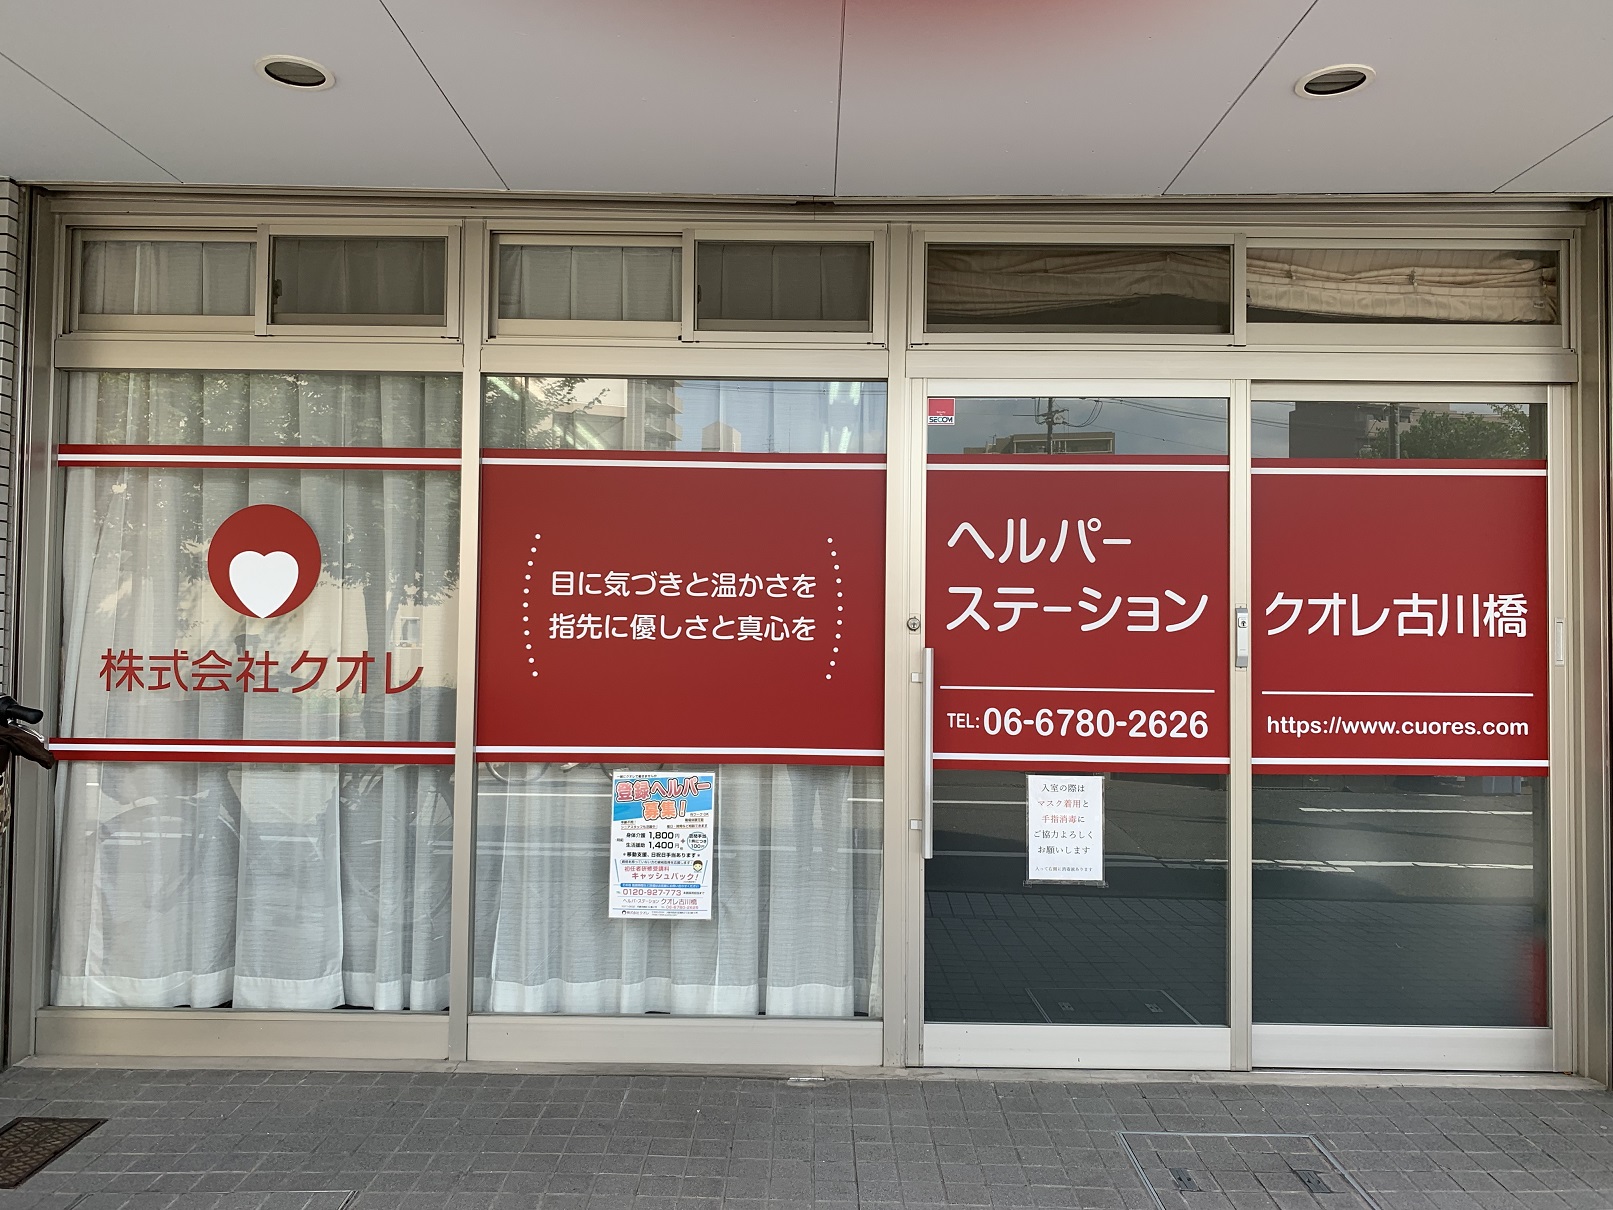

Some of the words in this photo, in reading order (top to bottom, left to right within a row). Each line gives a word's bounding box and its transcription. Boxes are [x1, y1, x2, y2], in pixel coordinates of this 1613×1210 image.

[948, 518, 1131, 563] ヘルパー
[551, 570, 816, 599] 目に気づきと温かさを
[946, 586, 1208, 633] ステーション
[1265, 591, 1528, 638] クオレ古川橋
[549, 612, 815, 642] 指先に優しさと真心を
[100, 648, 422, 695] 株式会社クオレ
[1267, 716, 1529, 738] https://www.cuores.com
[616, 776, 711, 802] 登録ヘルパー
[1041, 783, 1085, 793] 入室の際は
[1038, 799, 1089, 808] マスク着用と
[1041, 815, 1085, 824] 手指消毒に
[1033, 829, 1093, 839] ご協力よろしく
[1037, 845, 1090, 855] お願いします
[622, 888, 682, 896] 0120-927-773
[660, 898, 698, 906] クオレ古川橋
